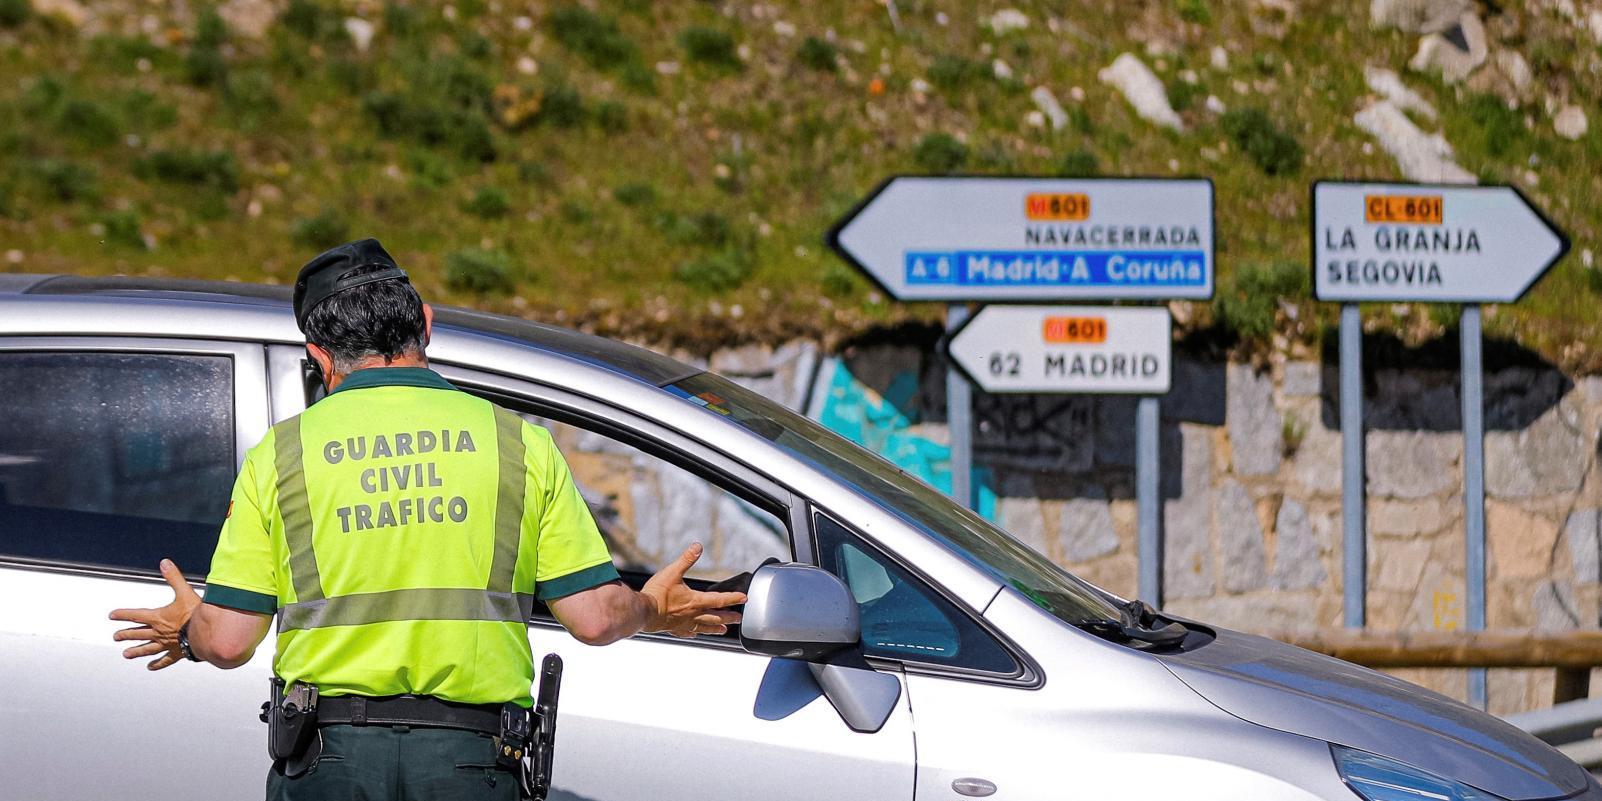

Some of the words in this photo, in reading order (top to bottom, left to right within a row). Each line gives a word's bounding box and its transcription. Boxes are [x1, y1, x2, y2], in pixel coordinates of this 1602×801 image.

[1026, 227, 1200, 245] NAVACERRADA
[1325, 227, 1356, 250] LA
[1375, 228, 1480, 252] GRANJA
[1107, 254, 1201, 280] Coruña
[1328, 261, 1442, 285] SEGOVIA
[989, 353, 1021, 375] 62
[1044, 353, 1159, 377] MADRID
[323, 429, 476, 464] GUARDIA
[360, 462, 442, 494] CIVIL
[336, 496, 468, 533] TRAFICO
